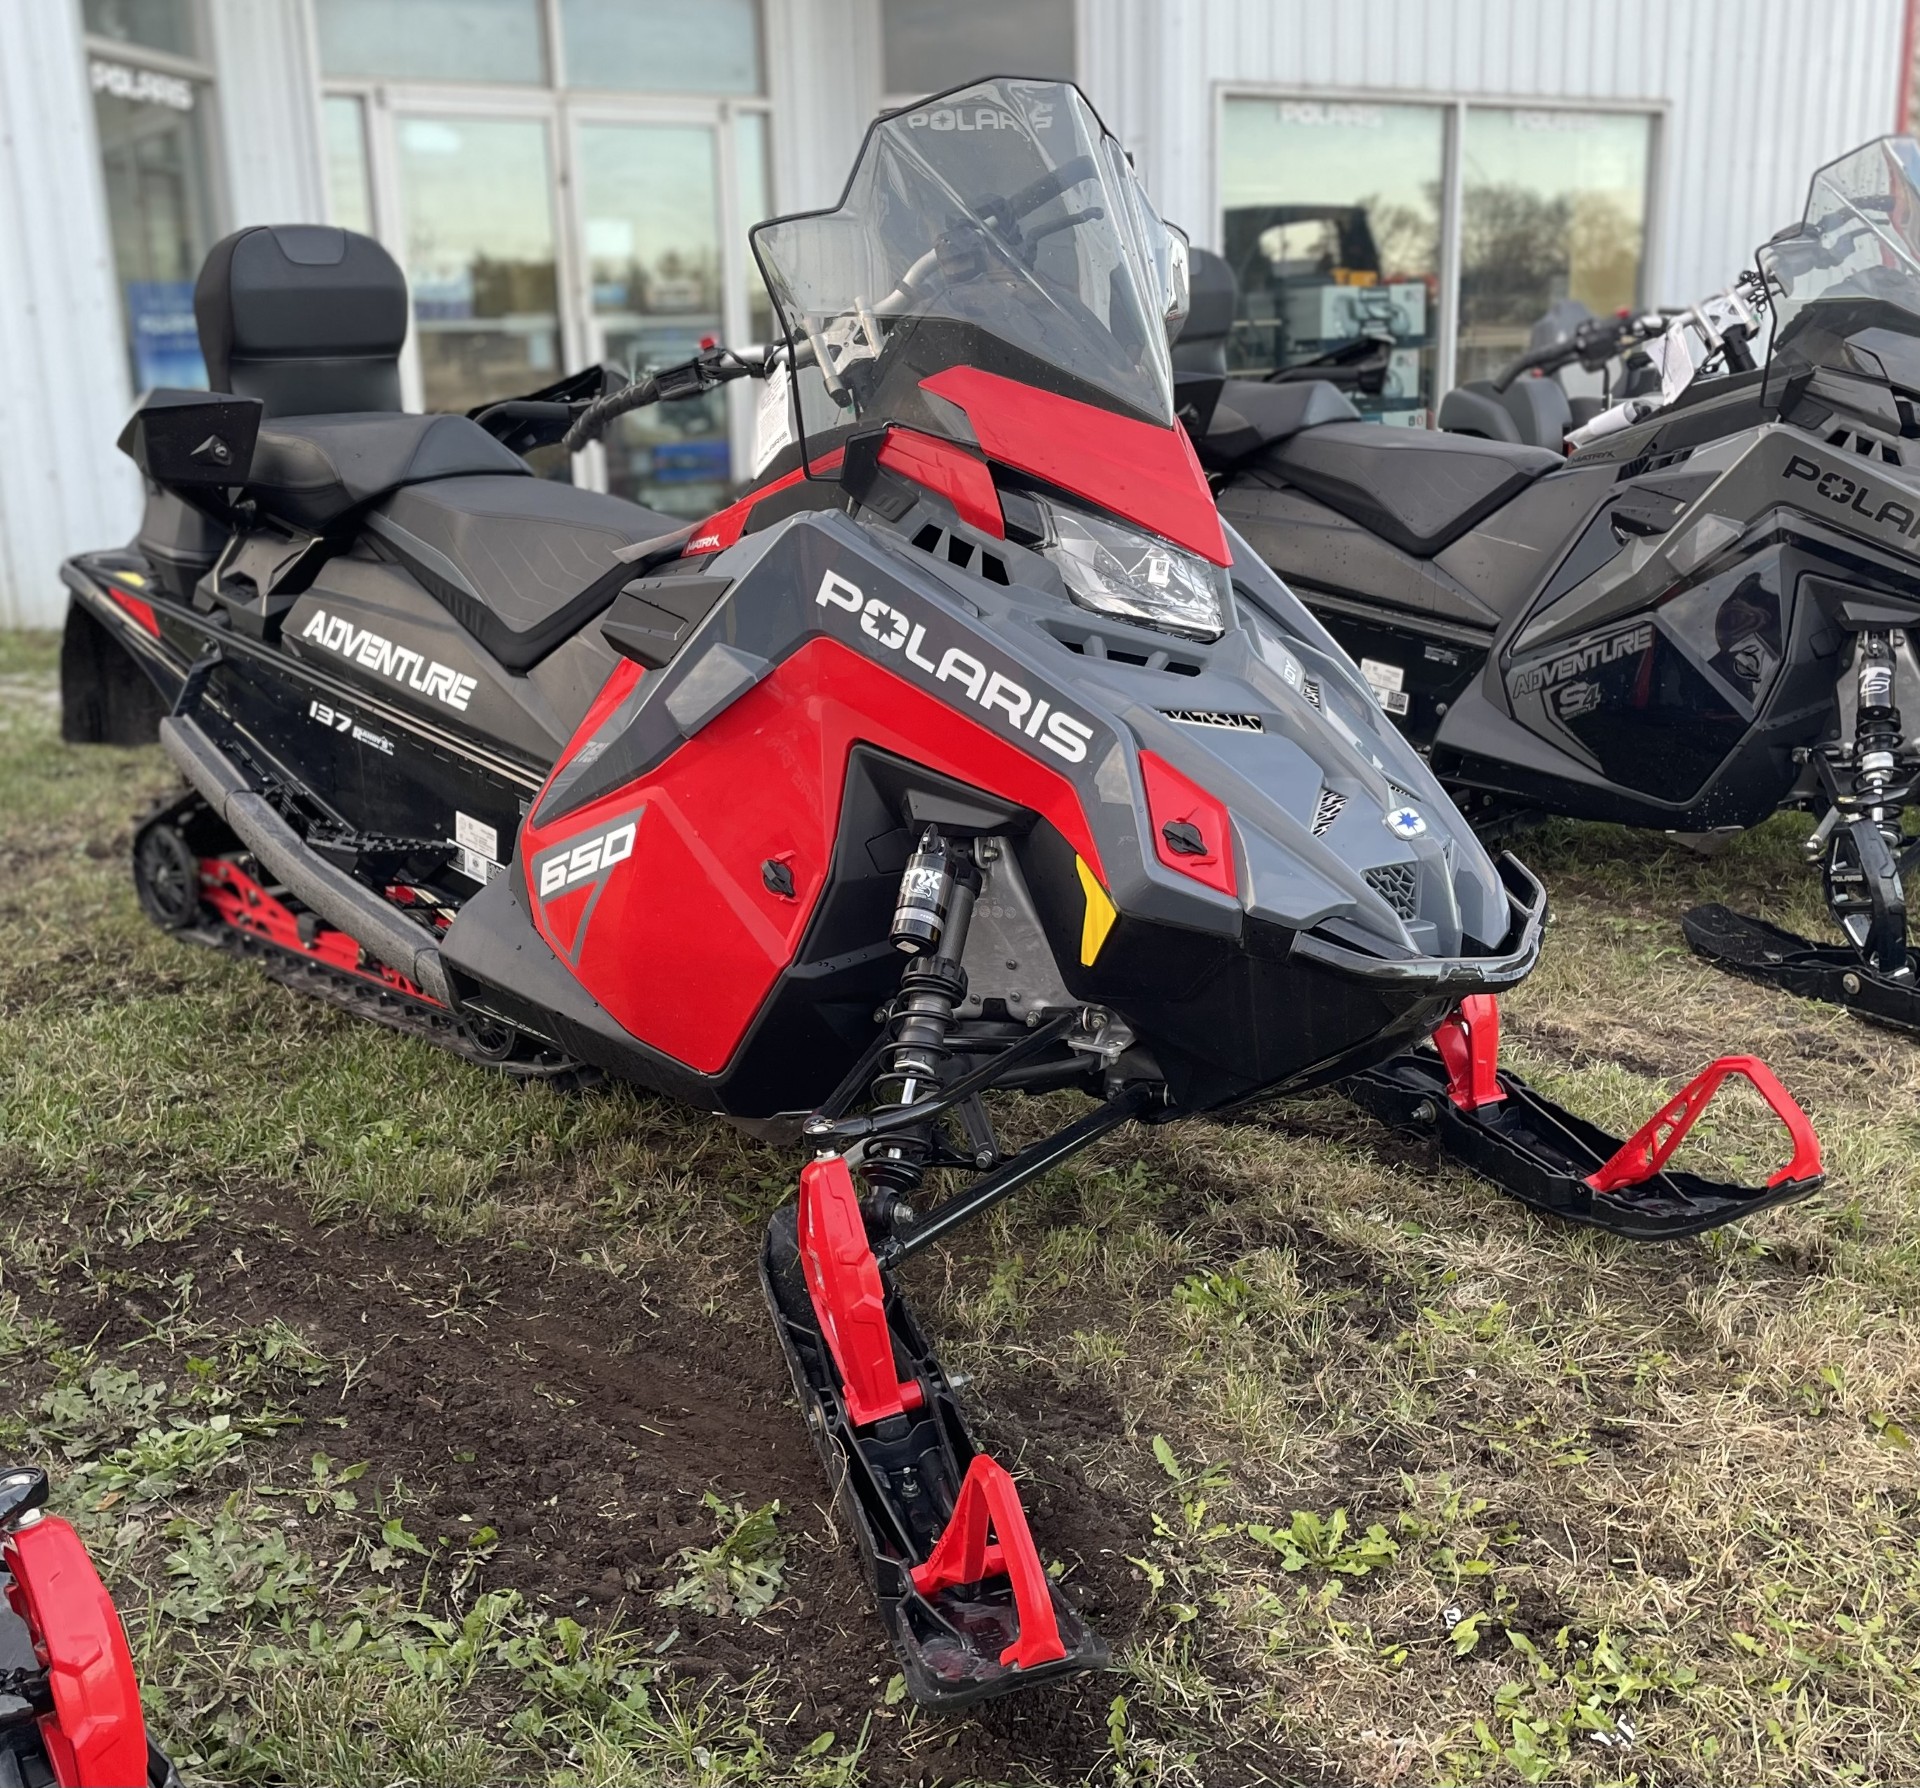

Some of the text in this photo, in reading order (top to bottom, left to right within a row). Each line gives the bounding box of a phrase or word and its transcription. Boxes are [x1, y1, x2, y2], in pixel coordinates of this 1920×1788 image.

[685, 534, 720, 554] MATRYX
[303, 610, 478, 712] ADVENTURE
[815, 569, 1094, 763] POLARIS
[1513, 624, 1653, 699] ADVENTURE
[540, 823, 636, 897] 650
